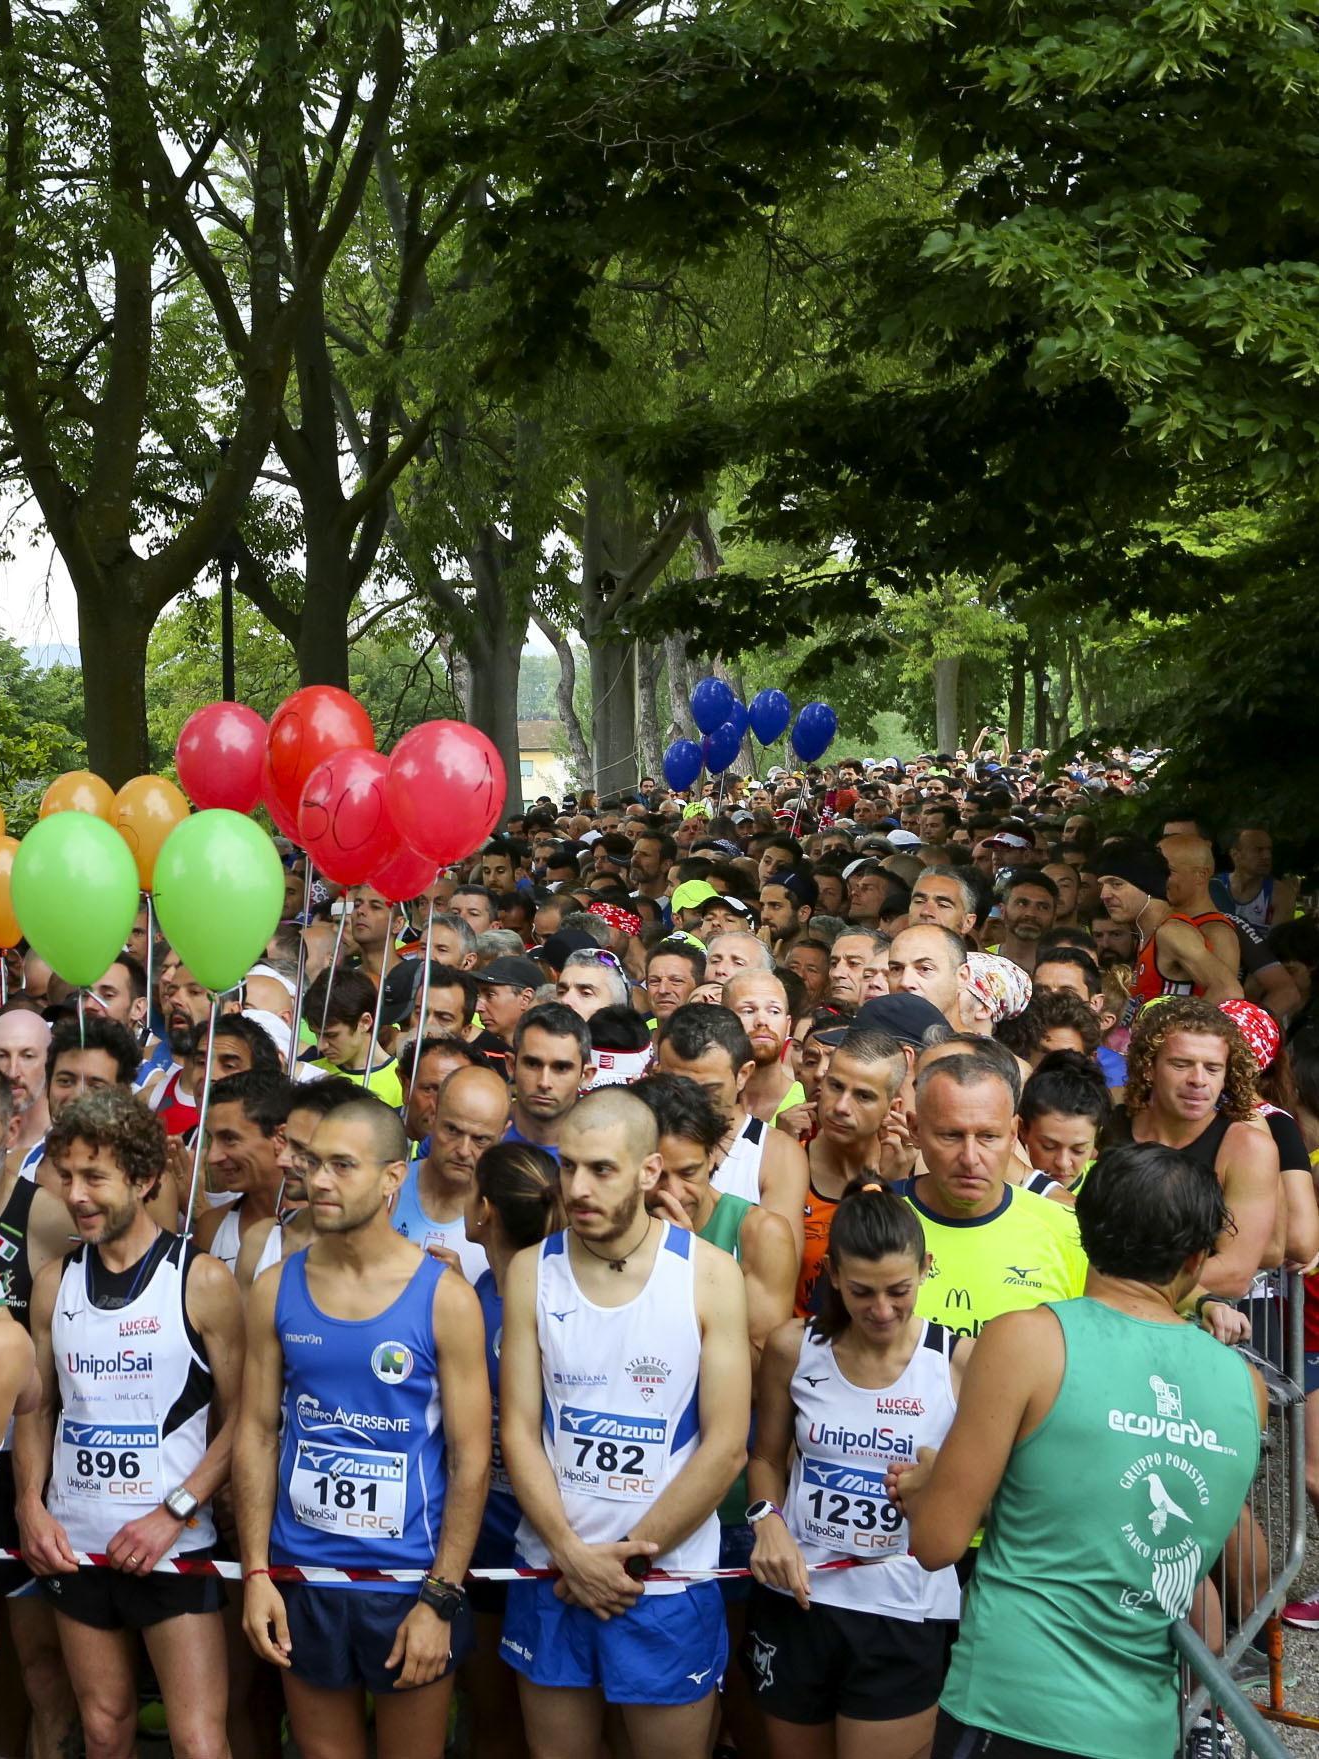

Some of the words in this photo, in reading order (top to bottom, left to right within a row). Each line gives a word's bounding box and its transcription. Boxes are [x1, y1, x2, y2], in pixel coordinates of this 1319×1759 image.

[119, 1319, 157, 1332] LUCCA
[119, 1329, 157, 1338] MARATHON
[285, 1332, 323, 1345] macron
[67, 1350, 153, 1380] UnipolSai
[624, 1355, 673, 1377] ATLETICA
[562, 1373, 608, 1382] ITALIANA
[876, 1397, 920, 1411] LUCCA
[876, 1407, 921, 1417] MARATHON
[298, 1404, 333, 1423] GRUPPO
[333, 1406, 411, 1432] AVERSENTE
[808, 1422, 914, 1456] UnipolSai
[1108, 1409, 1224, 1454] ecoverde
[76, 1449, 141, 1479] 896
[573, 1437, 645, 1476] 782
[849, 1449, 912, 1463] ASSICURAZIONI
[66, 1475, 102, 1492] UnipolSai
[108, 1481, 153, 1495] CRC
[607, 1475, 655, 1494] CRC
[1119, 1452, 1162, 1490] GRUPPO
[1165, 1452, 1210, 1506] PODISTICO
[313, 1476, 378, 1512] 181
[299, 1504, 338, 1522] UnipolSai
[345, 1512, 394, 1529] CRC
[808, 1489, 904, 1533] 1239
[804, 1518, 846, 1540] UnipolSai
[853, 1532, 903, 1548] CRC
[1120, 1521, 1151, 1560] PARCO
[1151, 1534, 1197, 1562] APUANE
